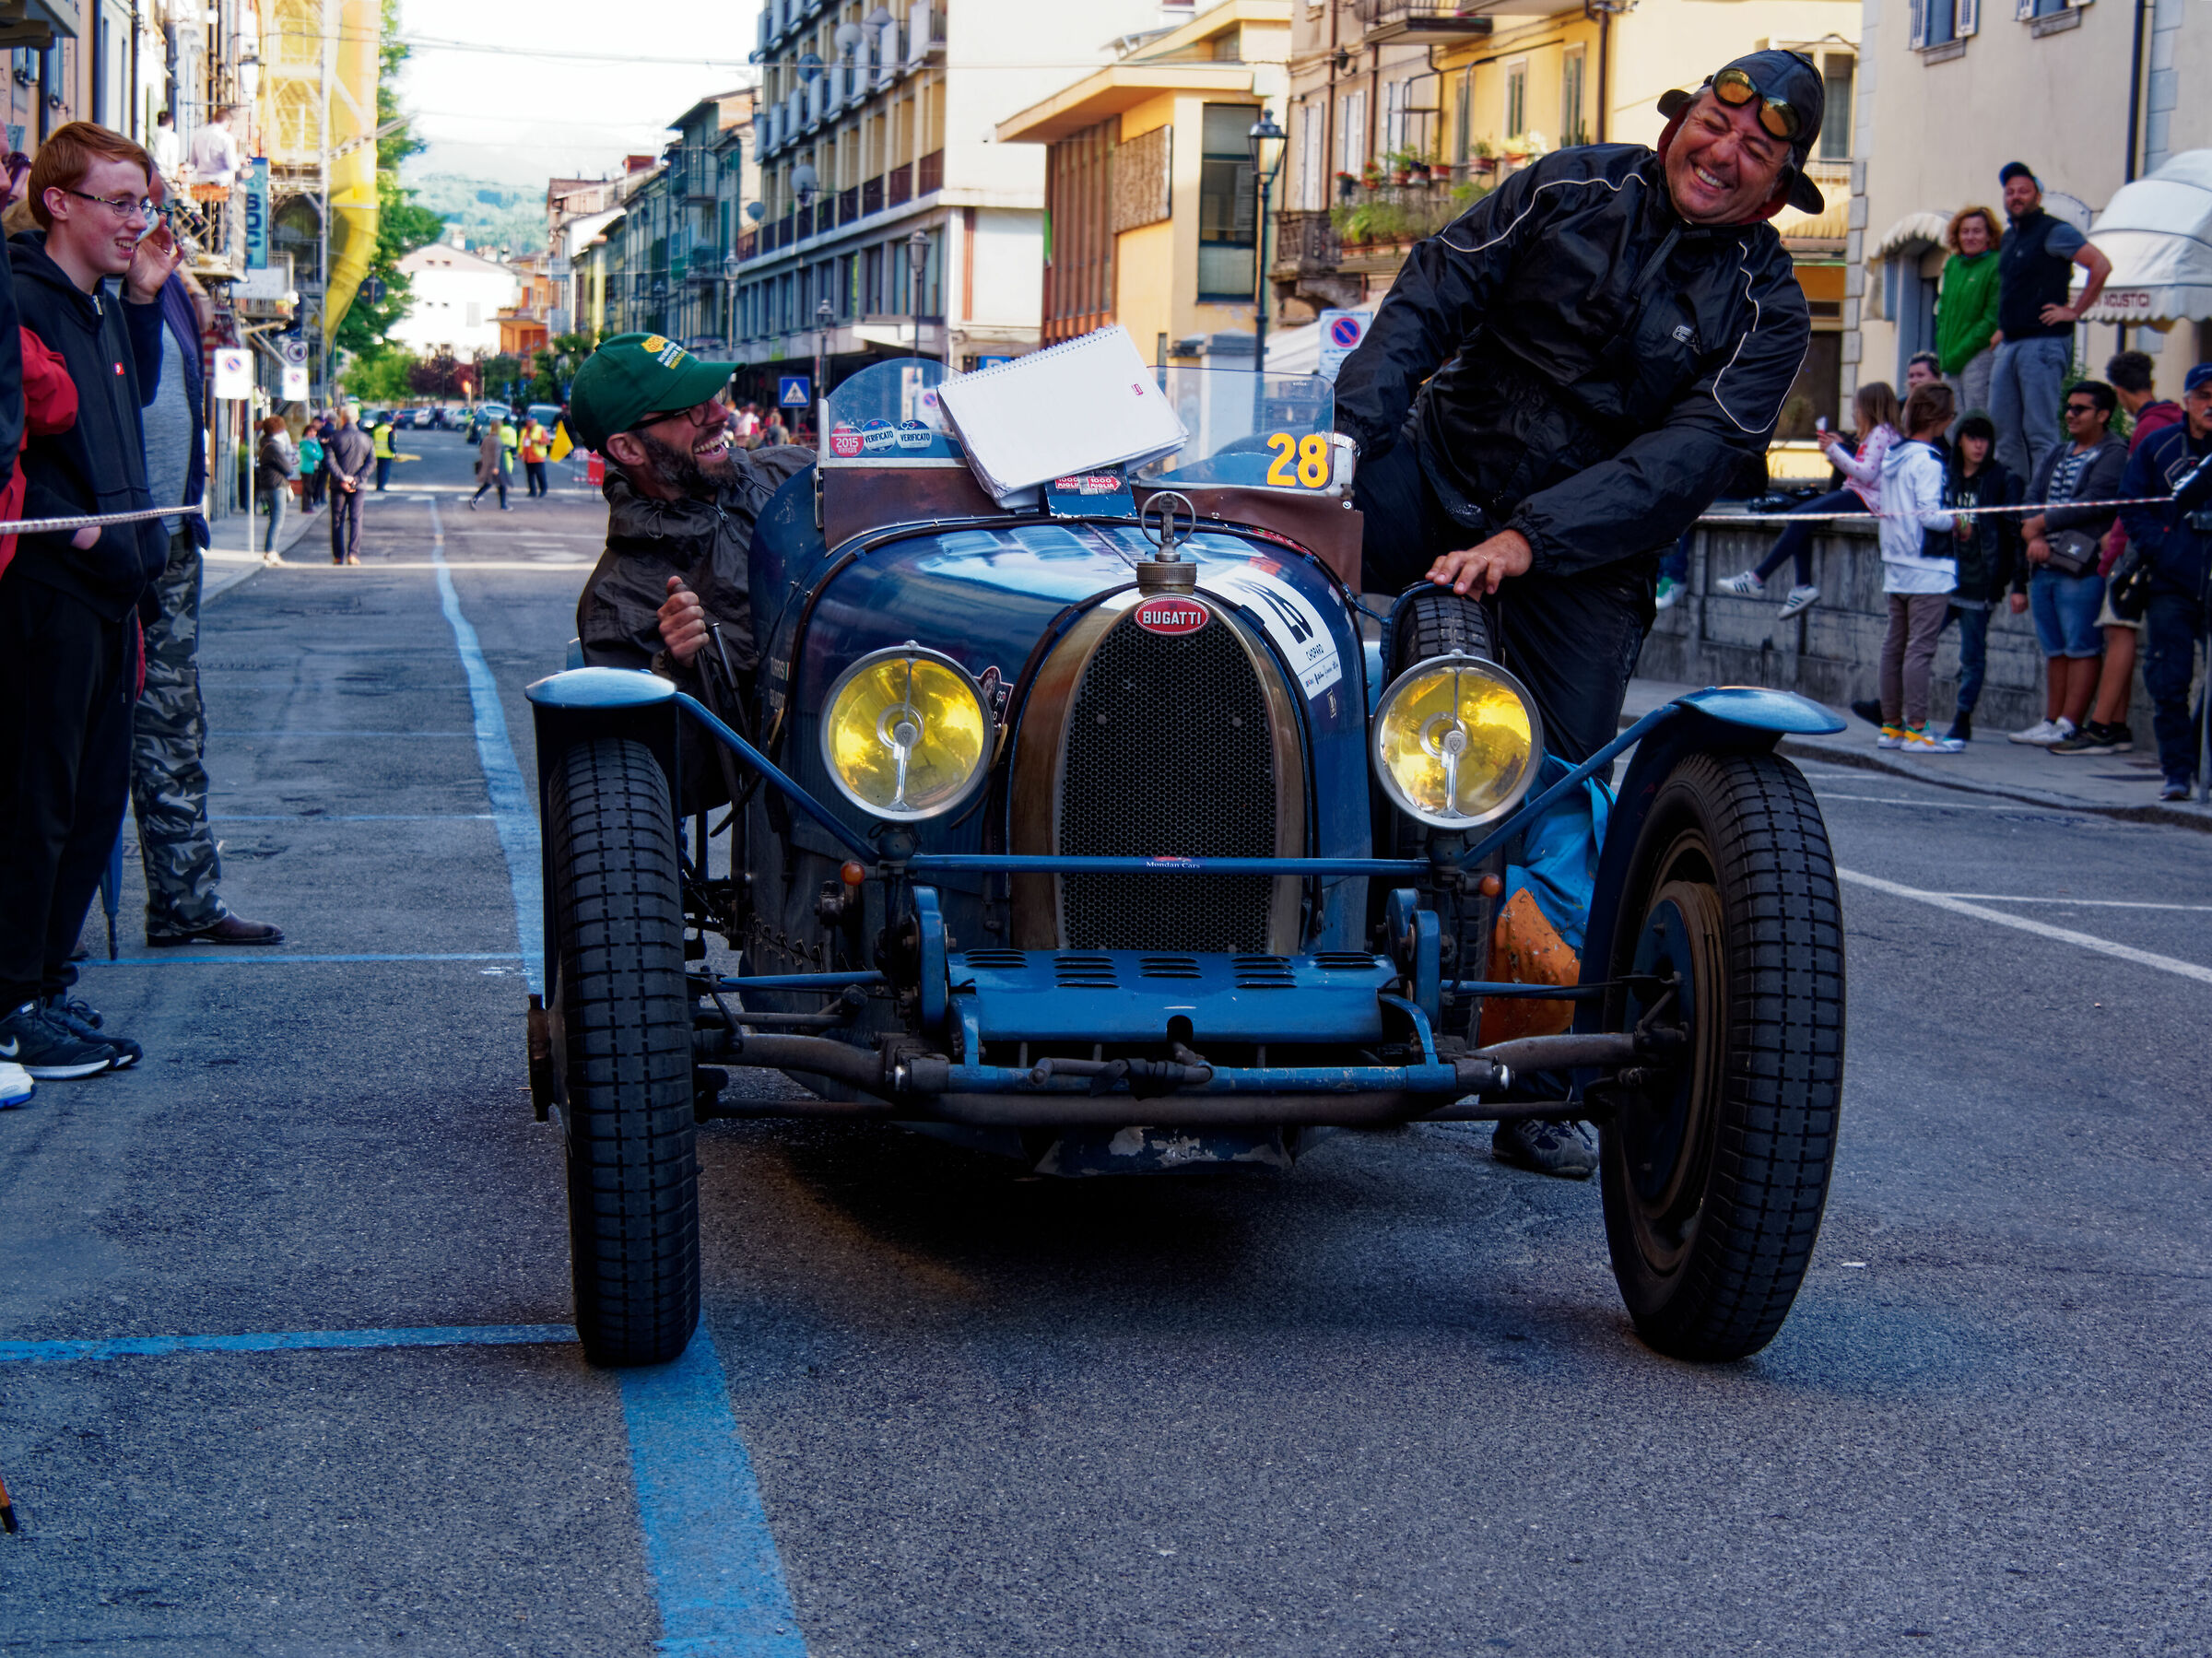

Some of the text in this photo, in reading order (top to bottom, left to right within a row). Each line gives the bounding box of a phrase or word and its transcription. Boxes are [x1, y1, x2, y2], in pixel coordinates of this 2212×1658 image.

[2104, 293, 2149, 307] ACUSTICI
[836, 437, 859, 448] 2015
[865, 430, 894, 443] VERIFICATO
[900, 433, 931, 442] VERIFICATO
[1266, 432, 1329, 488] 28
[1142, 610, 1202, 626] BUGATTI
